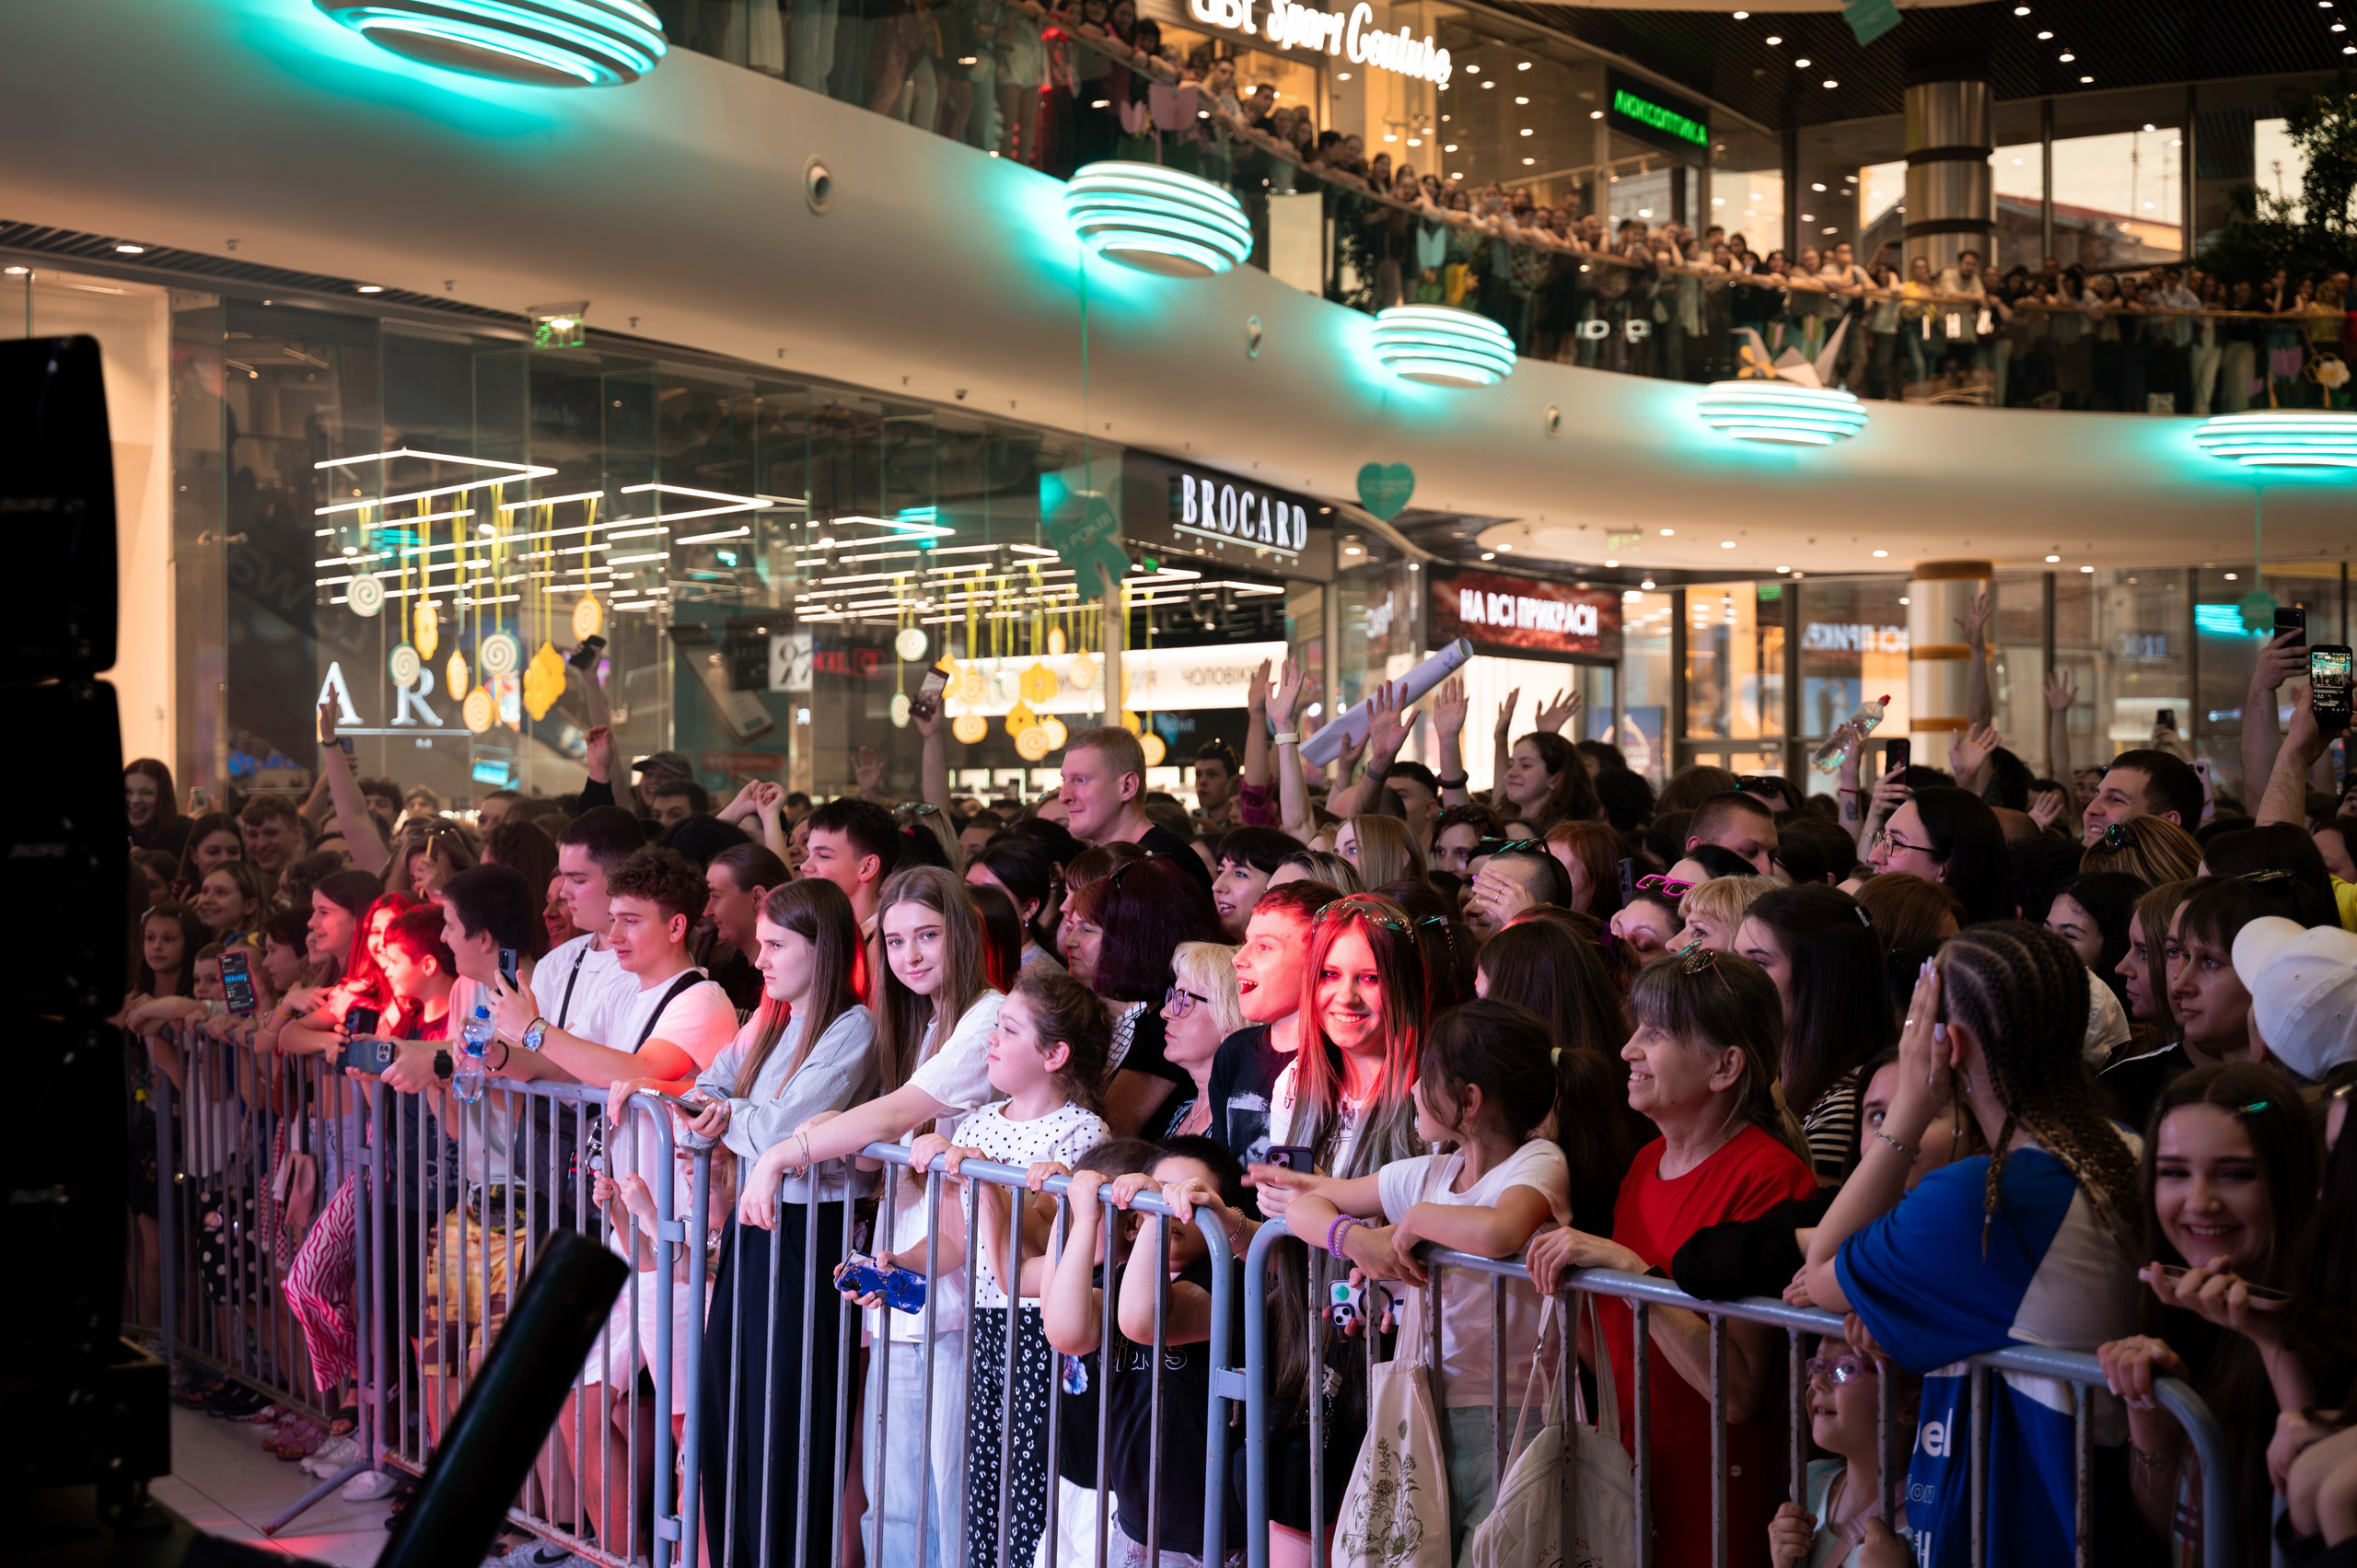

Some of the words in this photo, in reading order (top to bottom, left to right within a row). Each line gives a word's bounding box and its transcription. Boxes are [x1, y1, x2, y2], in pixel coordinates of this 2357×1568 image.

[1267, 0, 1344, 54] Sport
[1347, 2, 1452, 84] Couture
[1614, 89, 1709, 146] ЛЮКСОПТИКА
[1181, 474, 1307, 552] BROCARD
[1460, 588, 1486, 624] НА
[1487, 592, 1515, 628] ВСІ
[1516, 596, 1597, 637] ПРИКРАСИ
[1182, 666, 1260, 686] ЧОЛОВІК
[1911, 1408, 1954, 1458] el
